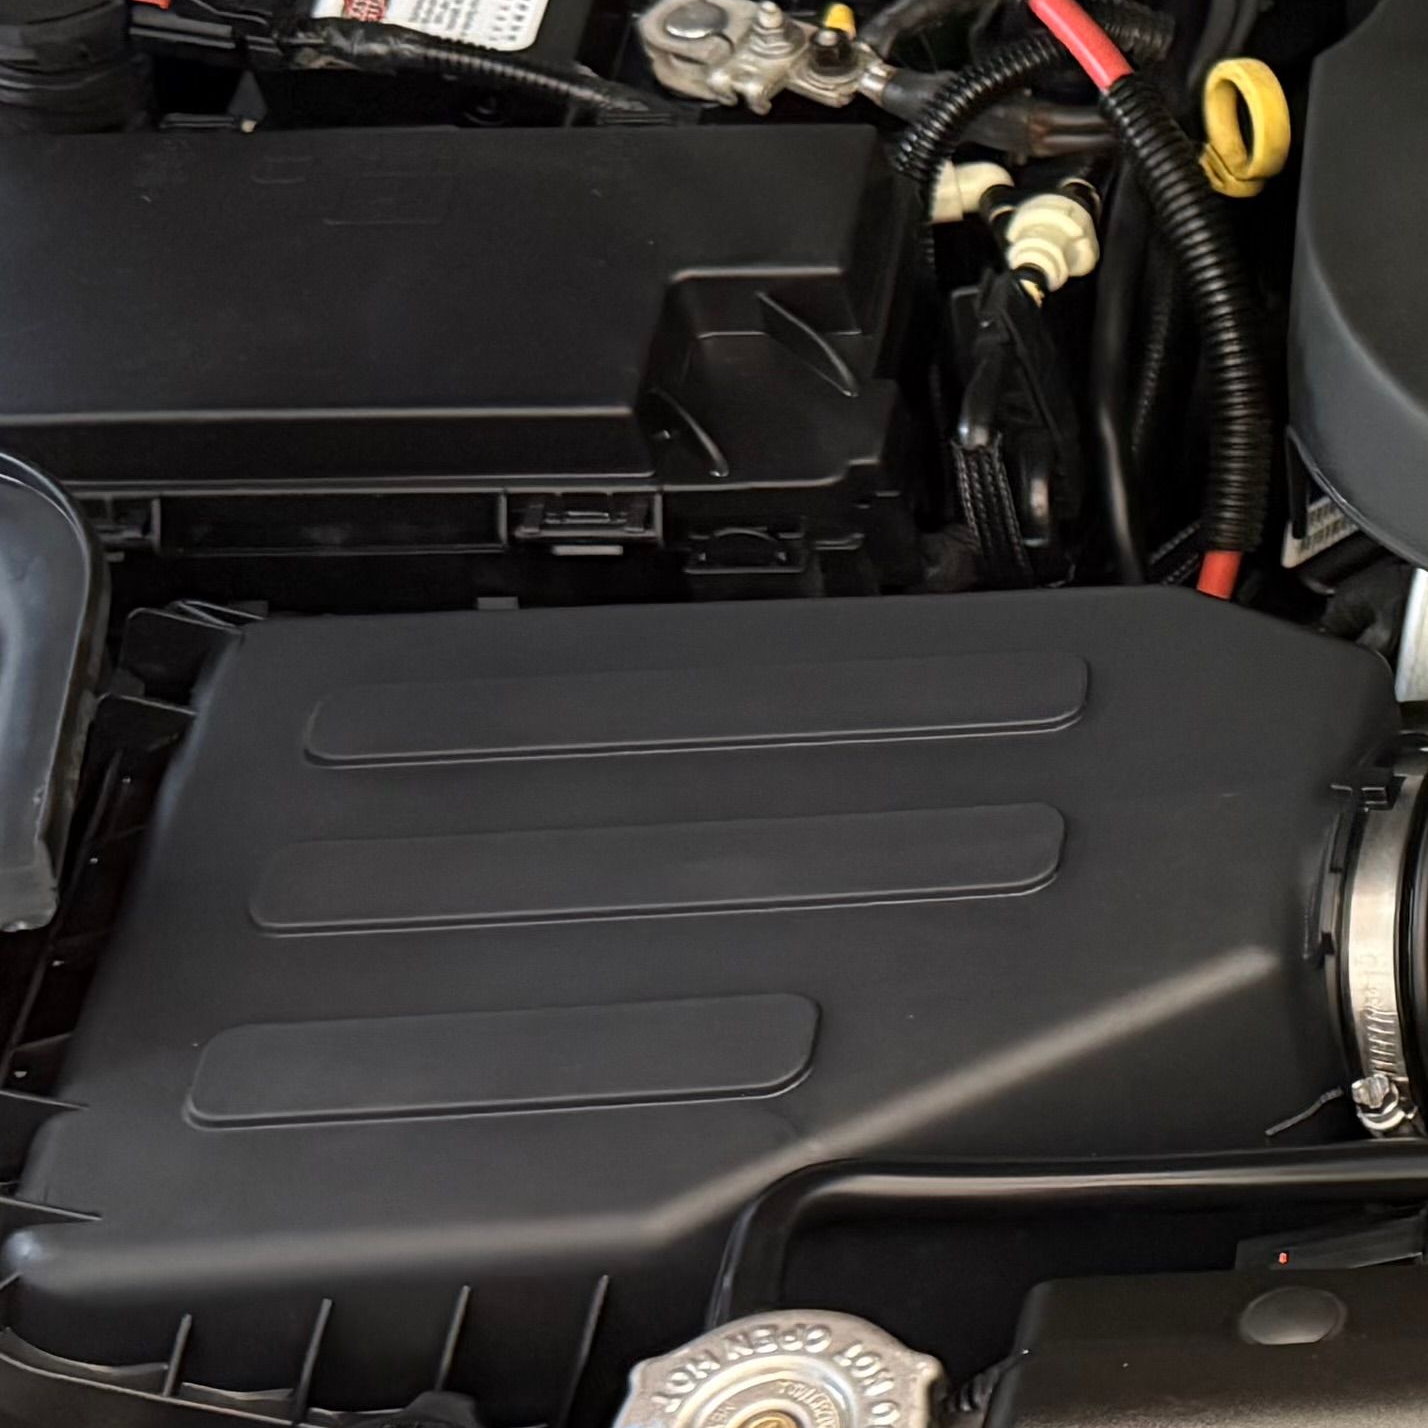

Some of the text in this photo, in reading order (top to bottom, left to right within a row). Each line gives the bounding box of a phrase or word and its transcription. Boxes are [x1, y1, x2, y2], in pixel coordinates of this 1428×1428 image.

[724, 1323, 832, 1361] OPEN
[832, 1341, 896, 1397] NOT
[651, 1349, 721, 1413] HOT
